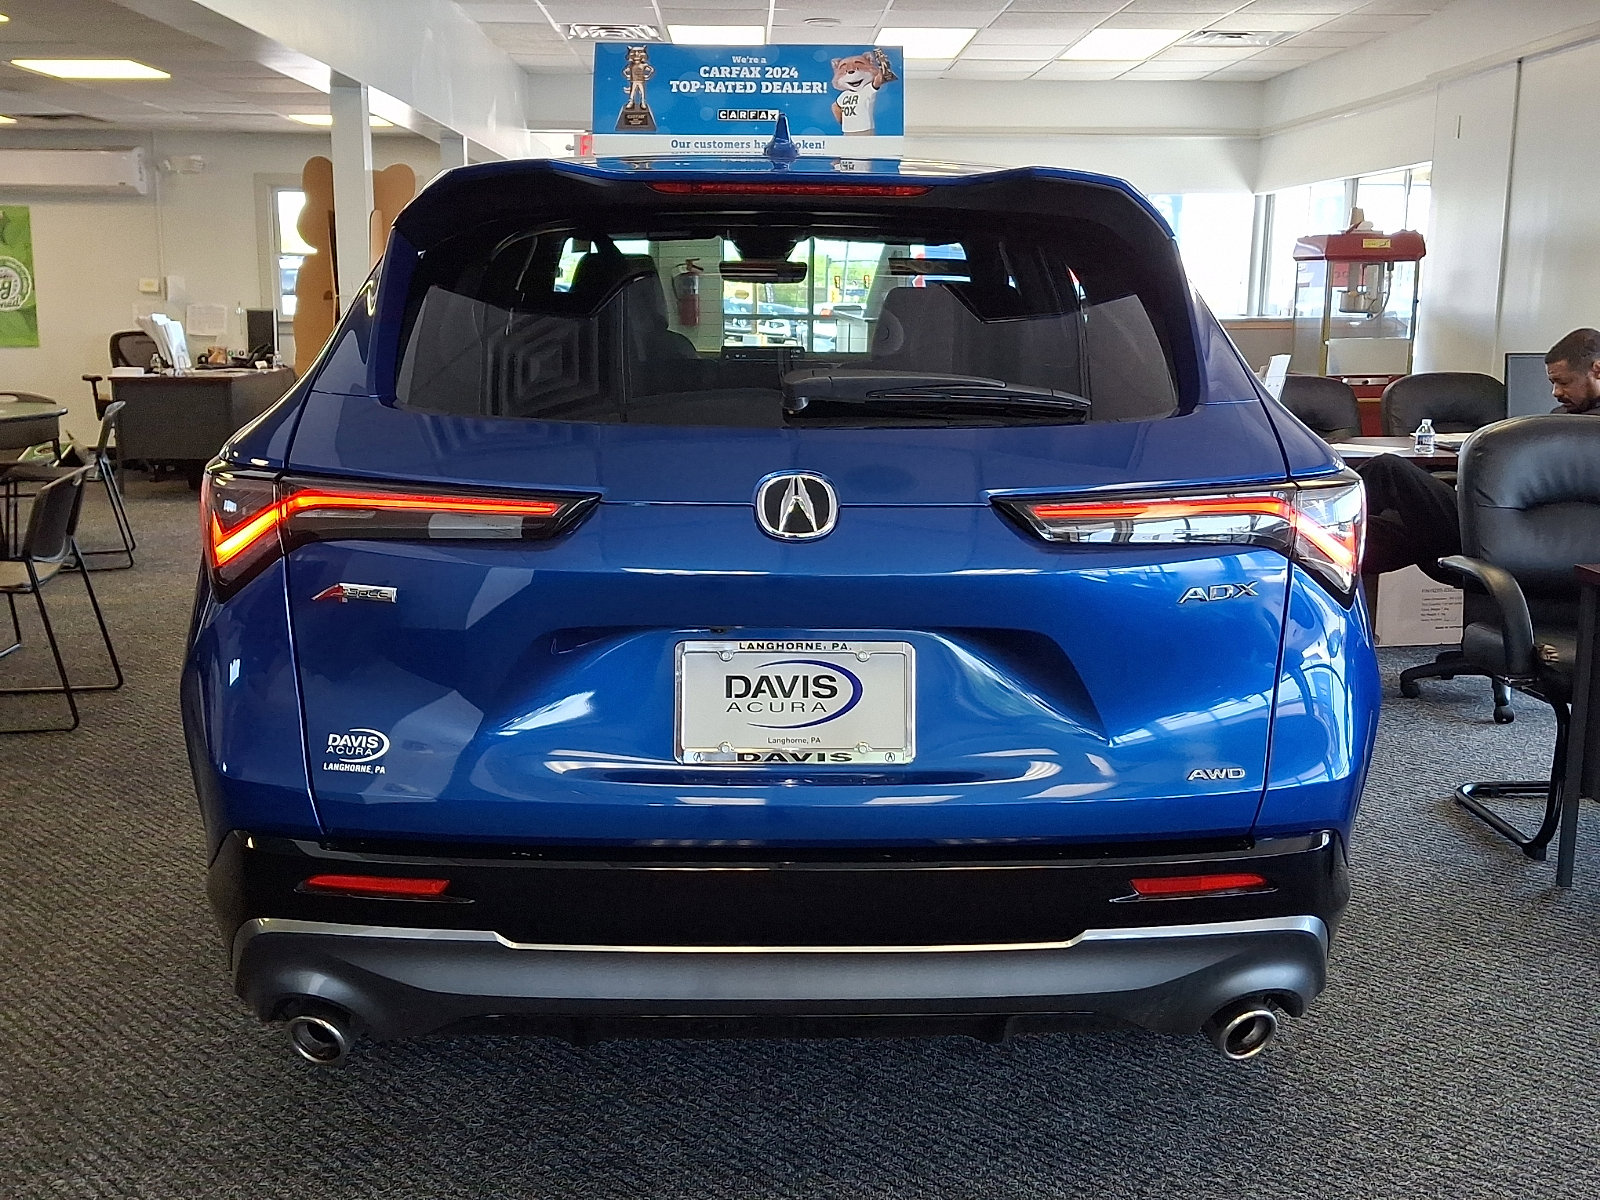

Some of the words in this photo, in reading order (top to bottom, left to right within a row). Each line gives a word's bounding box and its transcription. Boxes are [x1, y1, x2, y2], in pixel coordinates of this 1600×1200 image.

[732, 56, 758, 64] We're
[700, 66, 761, 78] CARFAX
[765, 67, 799, 79] 2024
[669, 80, 757, 94] TOP-RATED
[761, 82, 828, 94] DEALER!
[843, 95, 859, 105] CAR
[718, 110, 778, 121] CARFAX
[671, 139, 691, 149] Our
[694, 140, 751, 149] customers
[796, 140, 825, 149] oken!
[1177, 581, 1259, 604] ADX
[725, 675, 838, 699] DAVIS
[726, 701, 828, 713] ACURA
[328, 733, 379, 749] DAVIS
[767, 737, 809, 745] Langhorne,
[326, 745, 373, 756] ACURA
[737, 752, 853, 762] DAVIS
[323, 762, 374, 775] LANGHORNE,
[375, 765, 386, 775] PA
[1188, 767, 1245, 781] AWD
